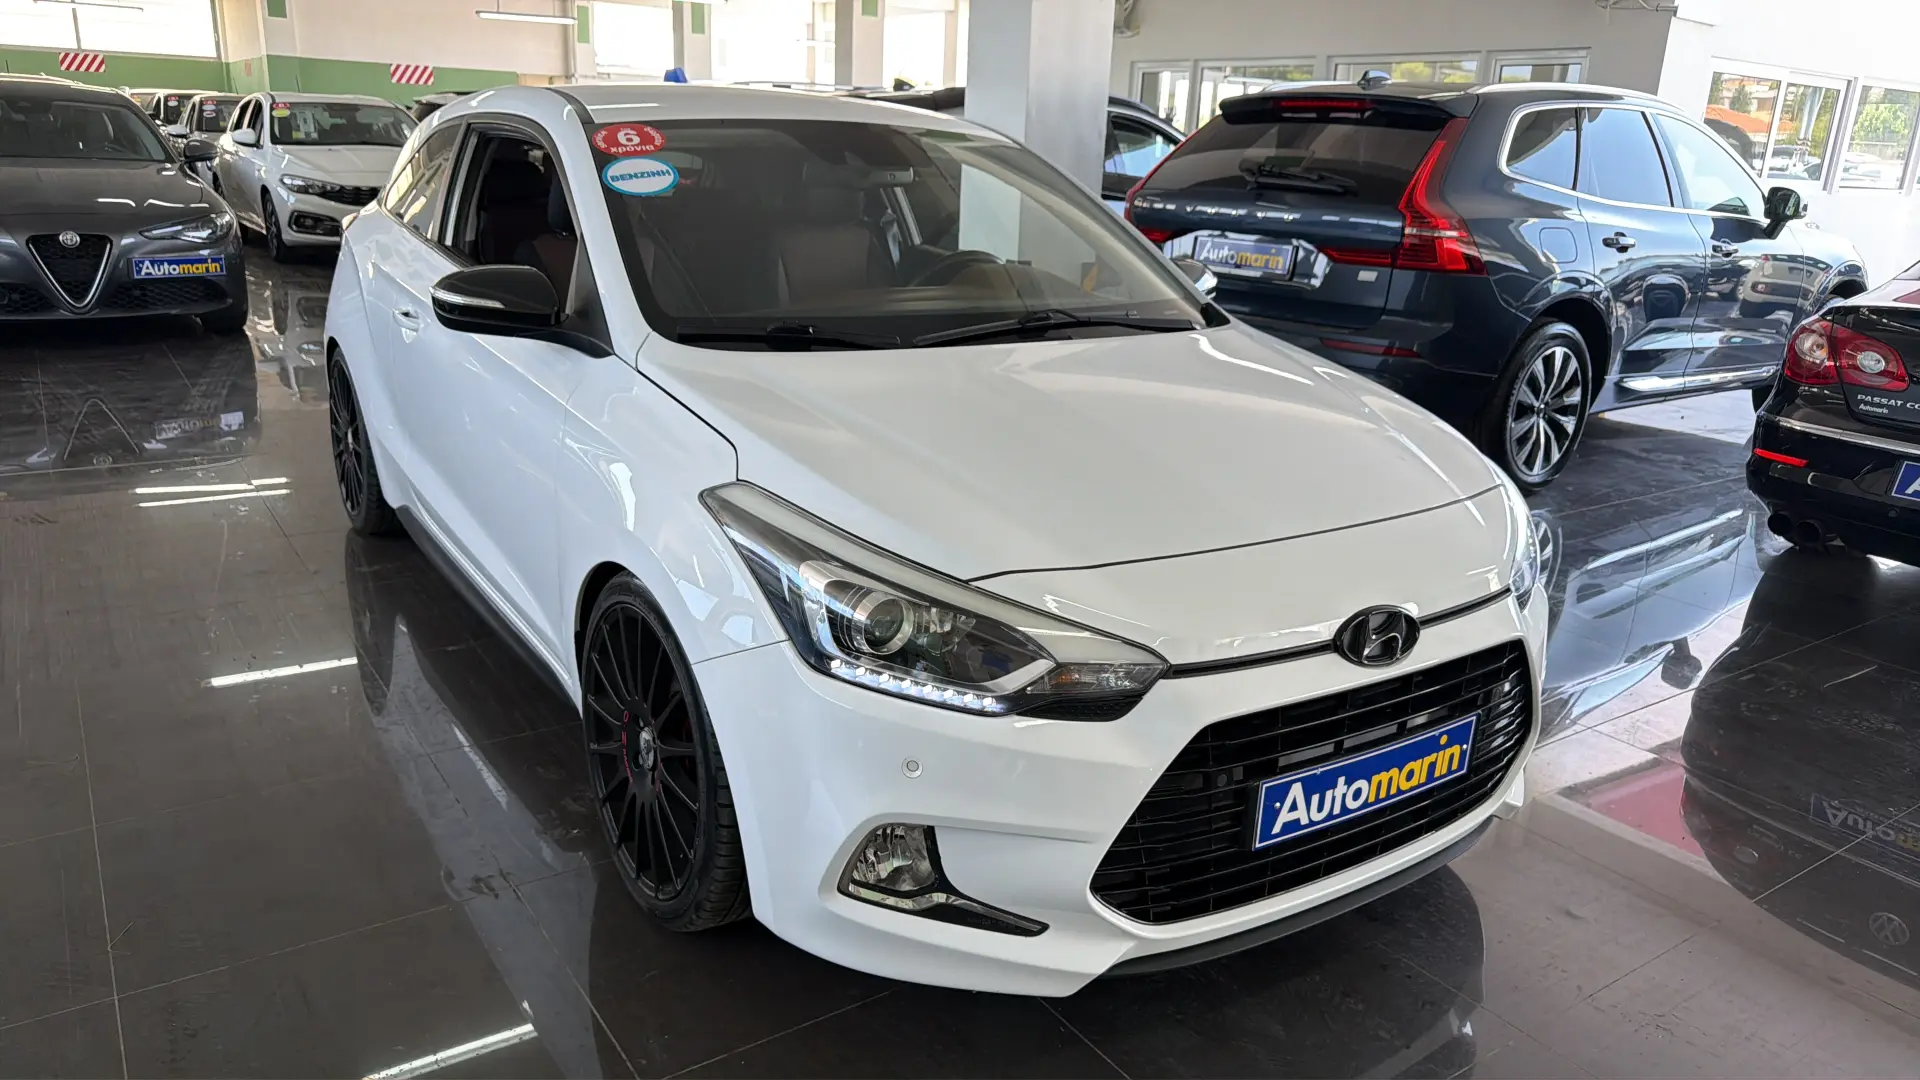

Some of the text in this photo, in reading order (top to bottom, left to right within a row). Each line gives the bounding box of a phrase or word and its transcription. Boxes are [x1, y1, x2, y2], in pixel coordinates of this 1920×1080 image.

[617, 129, 641, 146] 6
[1200, 241, 1284, 270] Automarin
[140, 258, 221, 276] Automarin
[1857, 394, 1904, 407] PASSAT
[1858, 403, 1889, 415] Automarin
[1271, 734, 1462, 835] Automarin
